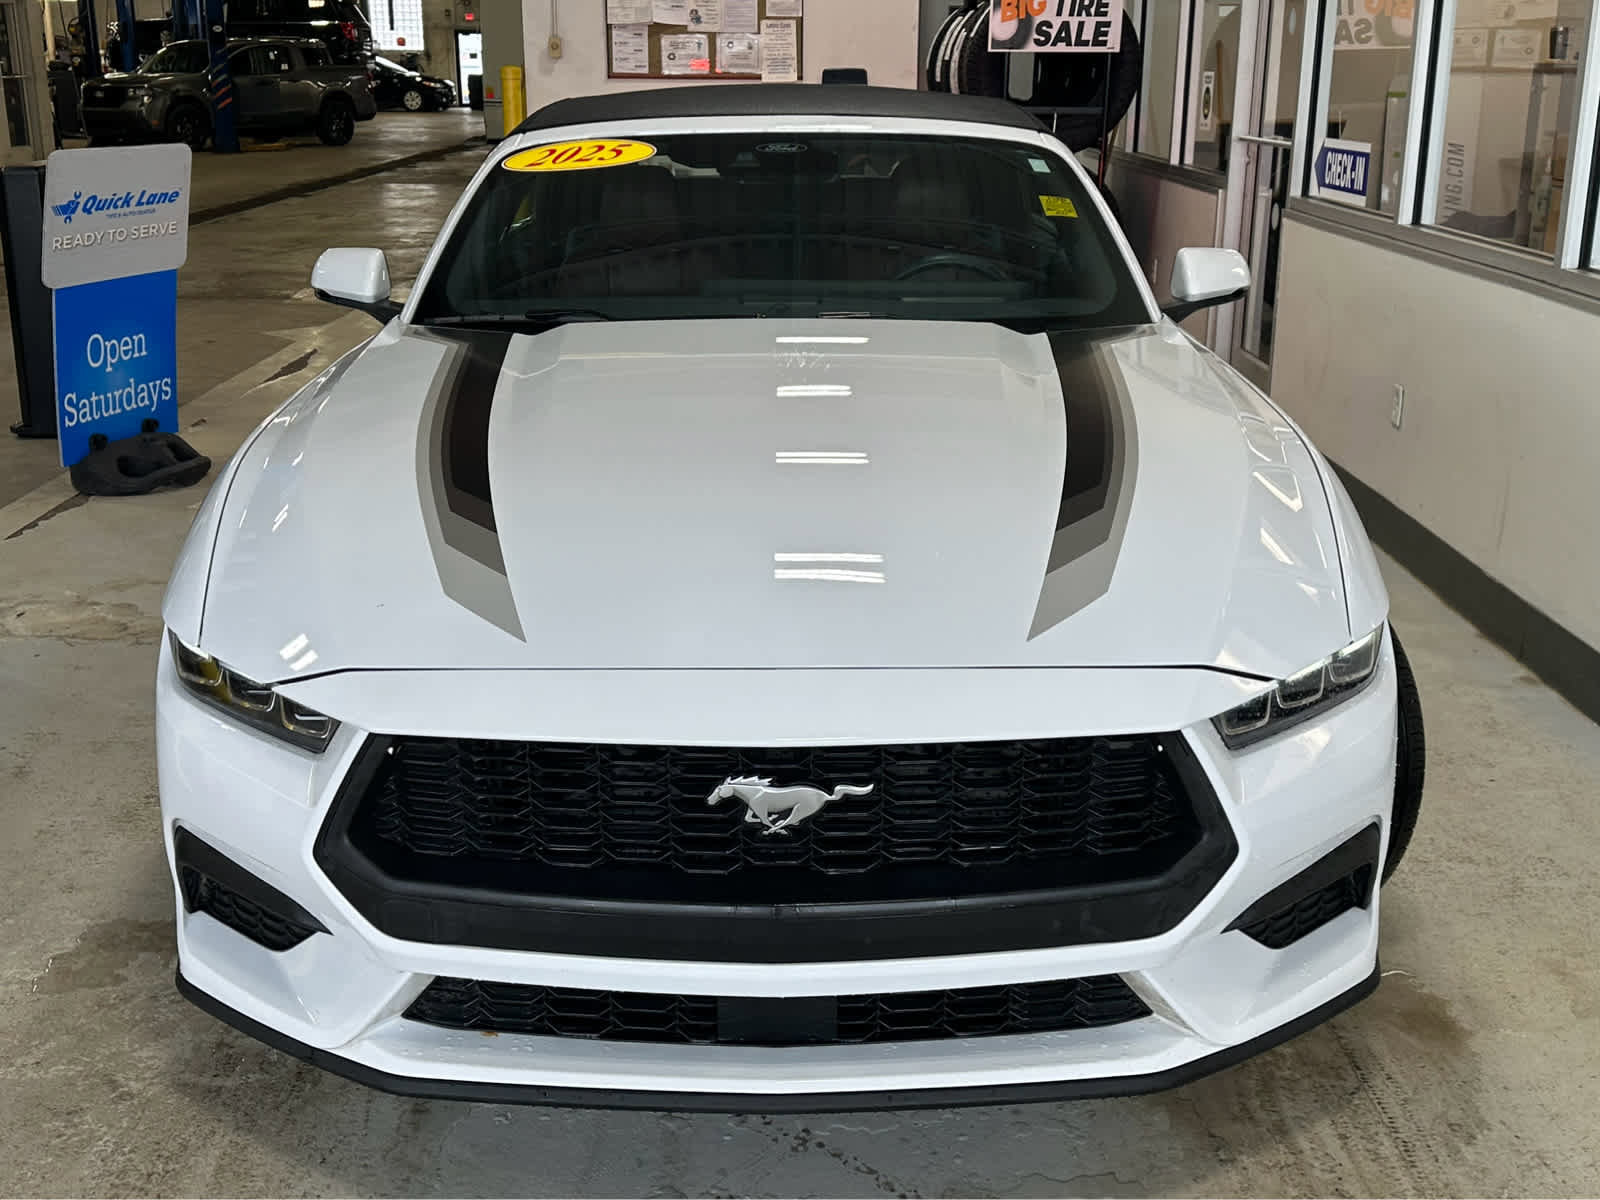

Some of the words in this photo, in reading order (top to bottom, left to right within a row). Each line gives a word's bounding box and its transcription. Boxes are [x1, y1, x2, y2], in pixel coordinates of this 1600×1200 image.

[1001, 0, 1047, 23] BIG
[1056, 0, 1110, 17] TIRE
[1033, 20, 1112, 47] SALE
[524, 144, 632, 167] 2025
[1325, 151, 1366, 191] CHECK-IN
[82, 192, 134, 215] Quick
[135, 190, 180, 207] Lane
[52, 230, 104, 250] READY
[108, 227, 127, 241] TO
[130, 221, 177, 239] SERVE
[87, 333, 147, 372] Open
[64, 377, 172, 427] Saturdays
